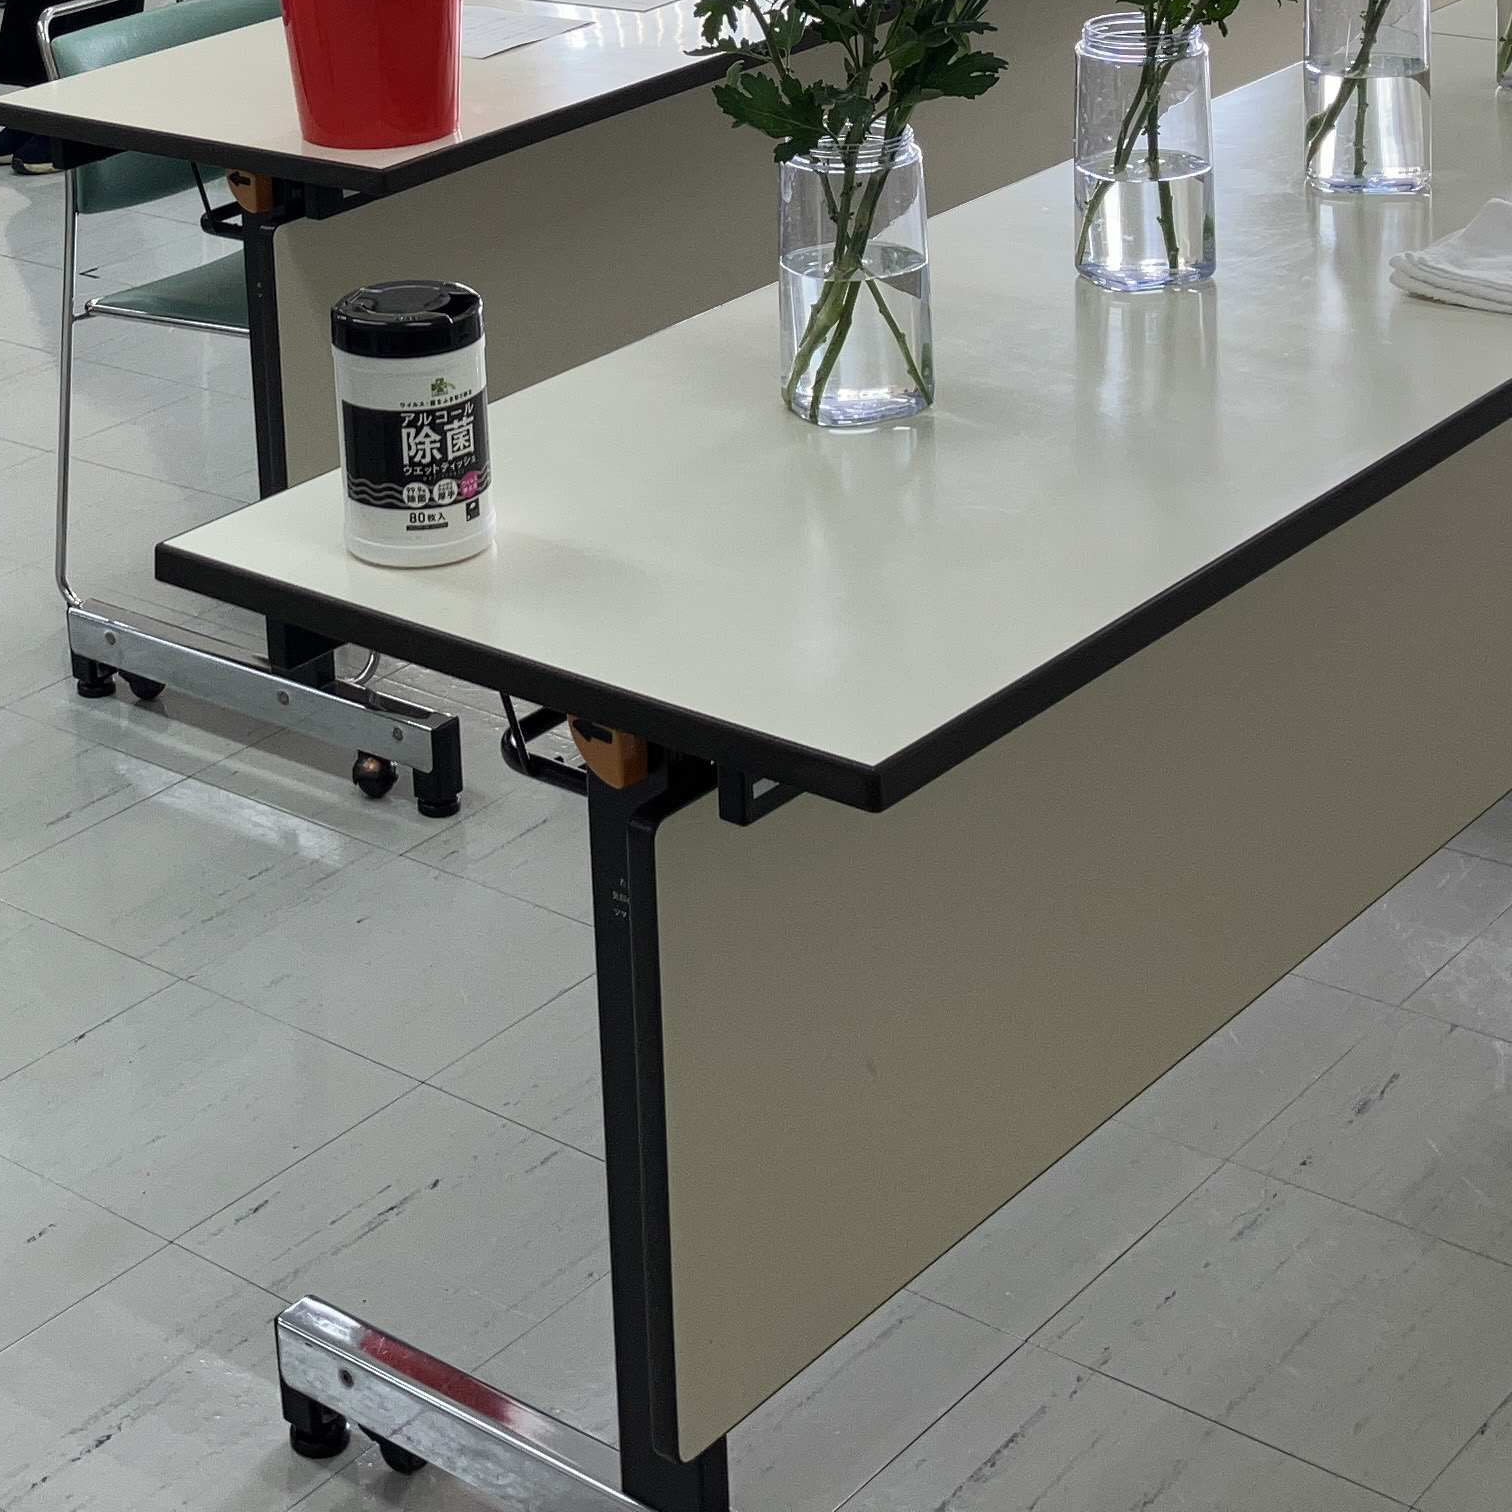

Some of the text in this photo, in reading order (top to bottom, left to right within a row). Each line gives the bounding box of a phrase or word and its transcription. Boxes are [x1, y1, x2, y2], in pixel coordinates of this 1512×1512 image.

[400, 401, 474, 427] アルコール
[401, 414, 476, 466] 除菌
[403, 454, 477, 476] ウエットティッシュ
[409, 511, 445, 524] 80枚入
